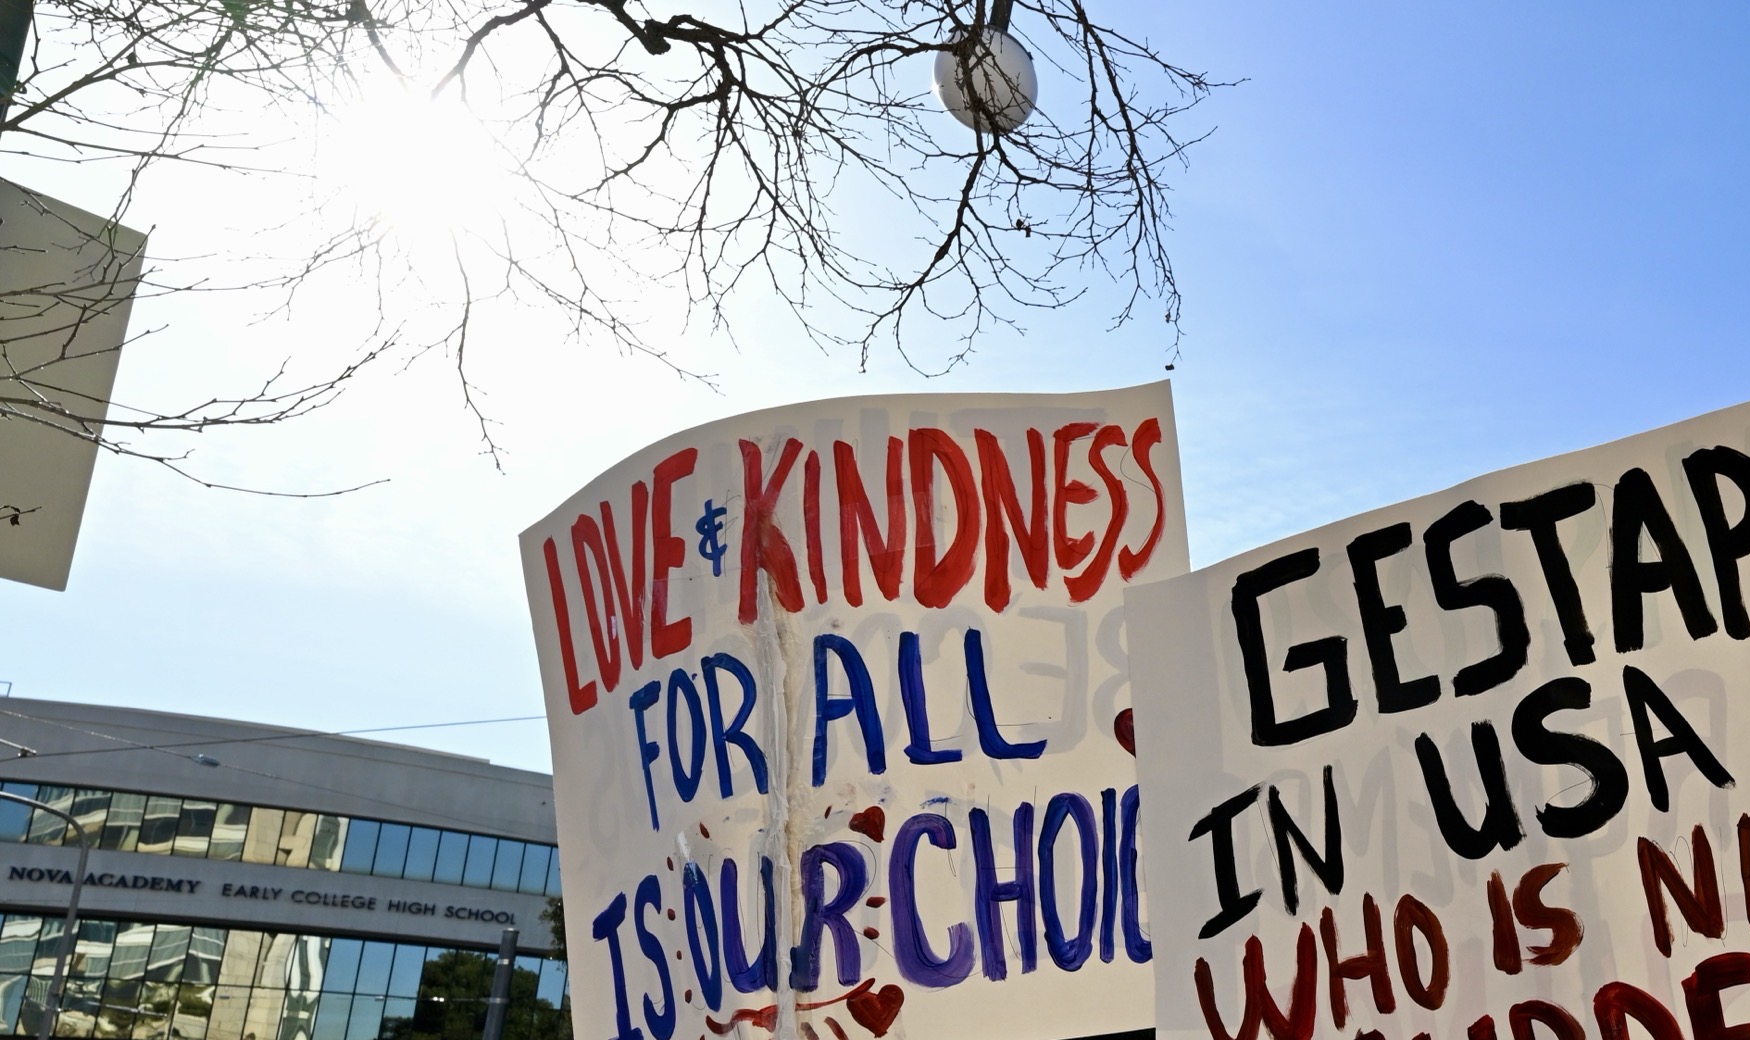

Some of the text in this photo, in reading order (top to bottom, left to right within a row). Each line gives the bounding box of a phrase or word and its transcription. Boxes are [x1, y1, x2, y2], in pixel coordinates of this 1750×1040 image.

[544, 448, 698, 715] LOVE
[737, 417, 1165, 626] KINDNESS
[629, 626, 1048, 832] FOR ALL
[1187, 664, 1737, 941] IN USA
[8, 866, 516, 926] NOVA ACADEMY EARLY COLLEGE HIGH SCHOOL
[682, 842, 870, 1014] OUR
[1486, 862, 1584, 978] IS
